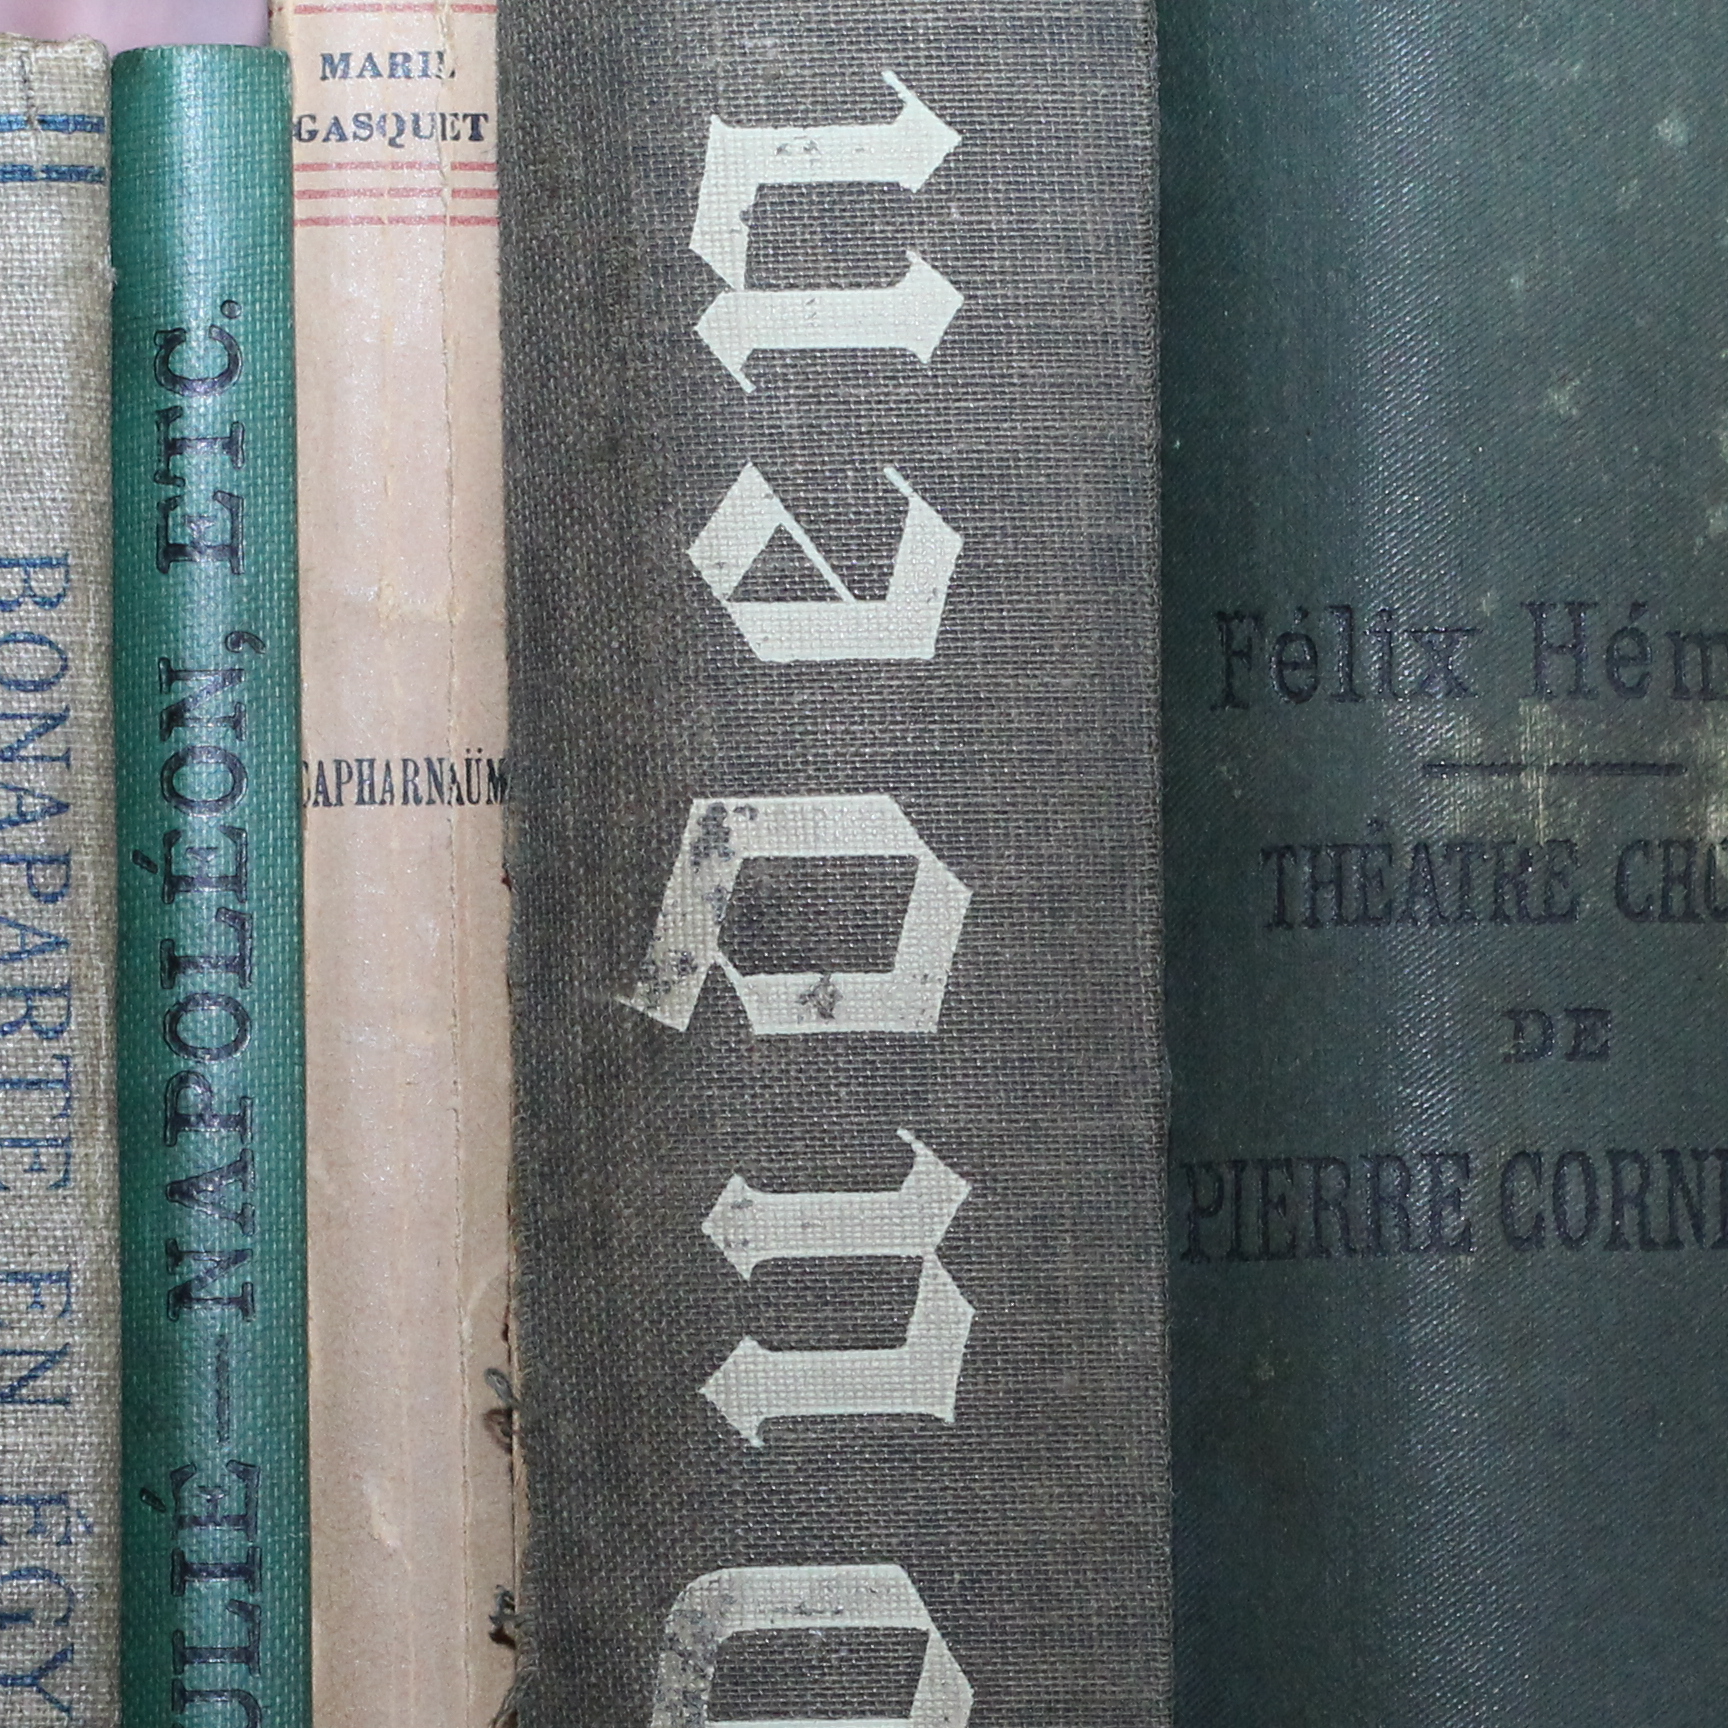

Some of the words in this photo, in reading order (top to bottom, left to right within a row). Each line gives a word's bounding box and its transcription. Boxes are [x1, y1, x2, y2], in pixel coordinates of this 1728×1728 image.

[292, 112, 490, 149] GASQUET
[152, 298, 246, 576] ETC.
[1209, 603, 1479, 711] Félix
[1501, 1007, 1612, 1064] DE
[1177, 1144, 1476, 1264] PIERRE
